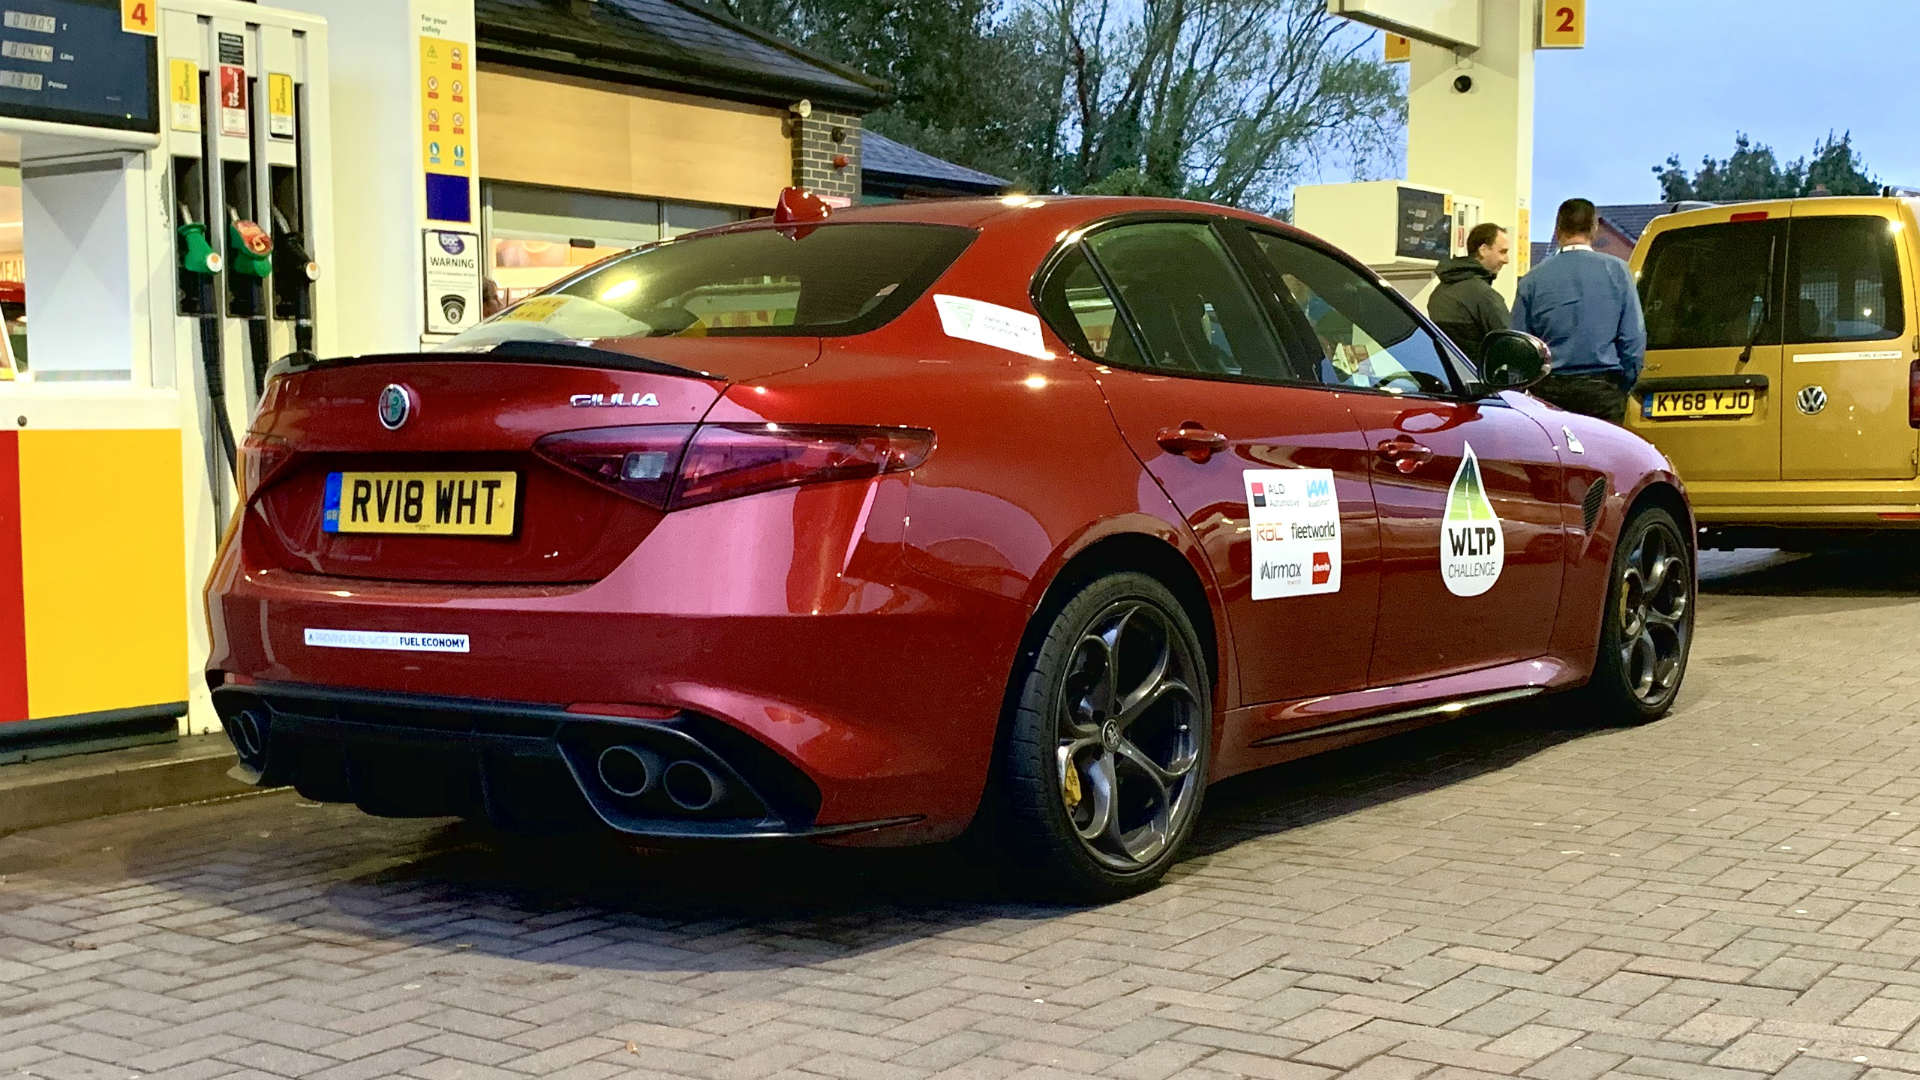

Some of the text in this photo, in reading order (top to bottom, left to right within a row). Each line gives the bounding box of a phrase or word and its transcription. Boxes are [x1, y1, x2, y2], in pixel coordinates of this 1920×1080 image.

[132, 3, 148, 26] 4
[1555, 7, 1575, 32] 2
[430, 256, 474, 269] WARNING
[570, 393, 659, 407] GIULIA
[1657, 393, 1706, 412] KY68
[351, 480, 501, 525] RV18 WHT
[1291, 521, 1336, 540] fleetworld
[1448, 527, 1496, 556] WLTP
[1448, 562, 1495, 578] CHALLENGE
[400, 637, 421, 647] FUEL
[422, 638, 465, 648] ECONOMY
